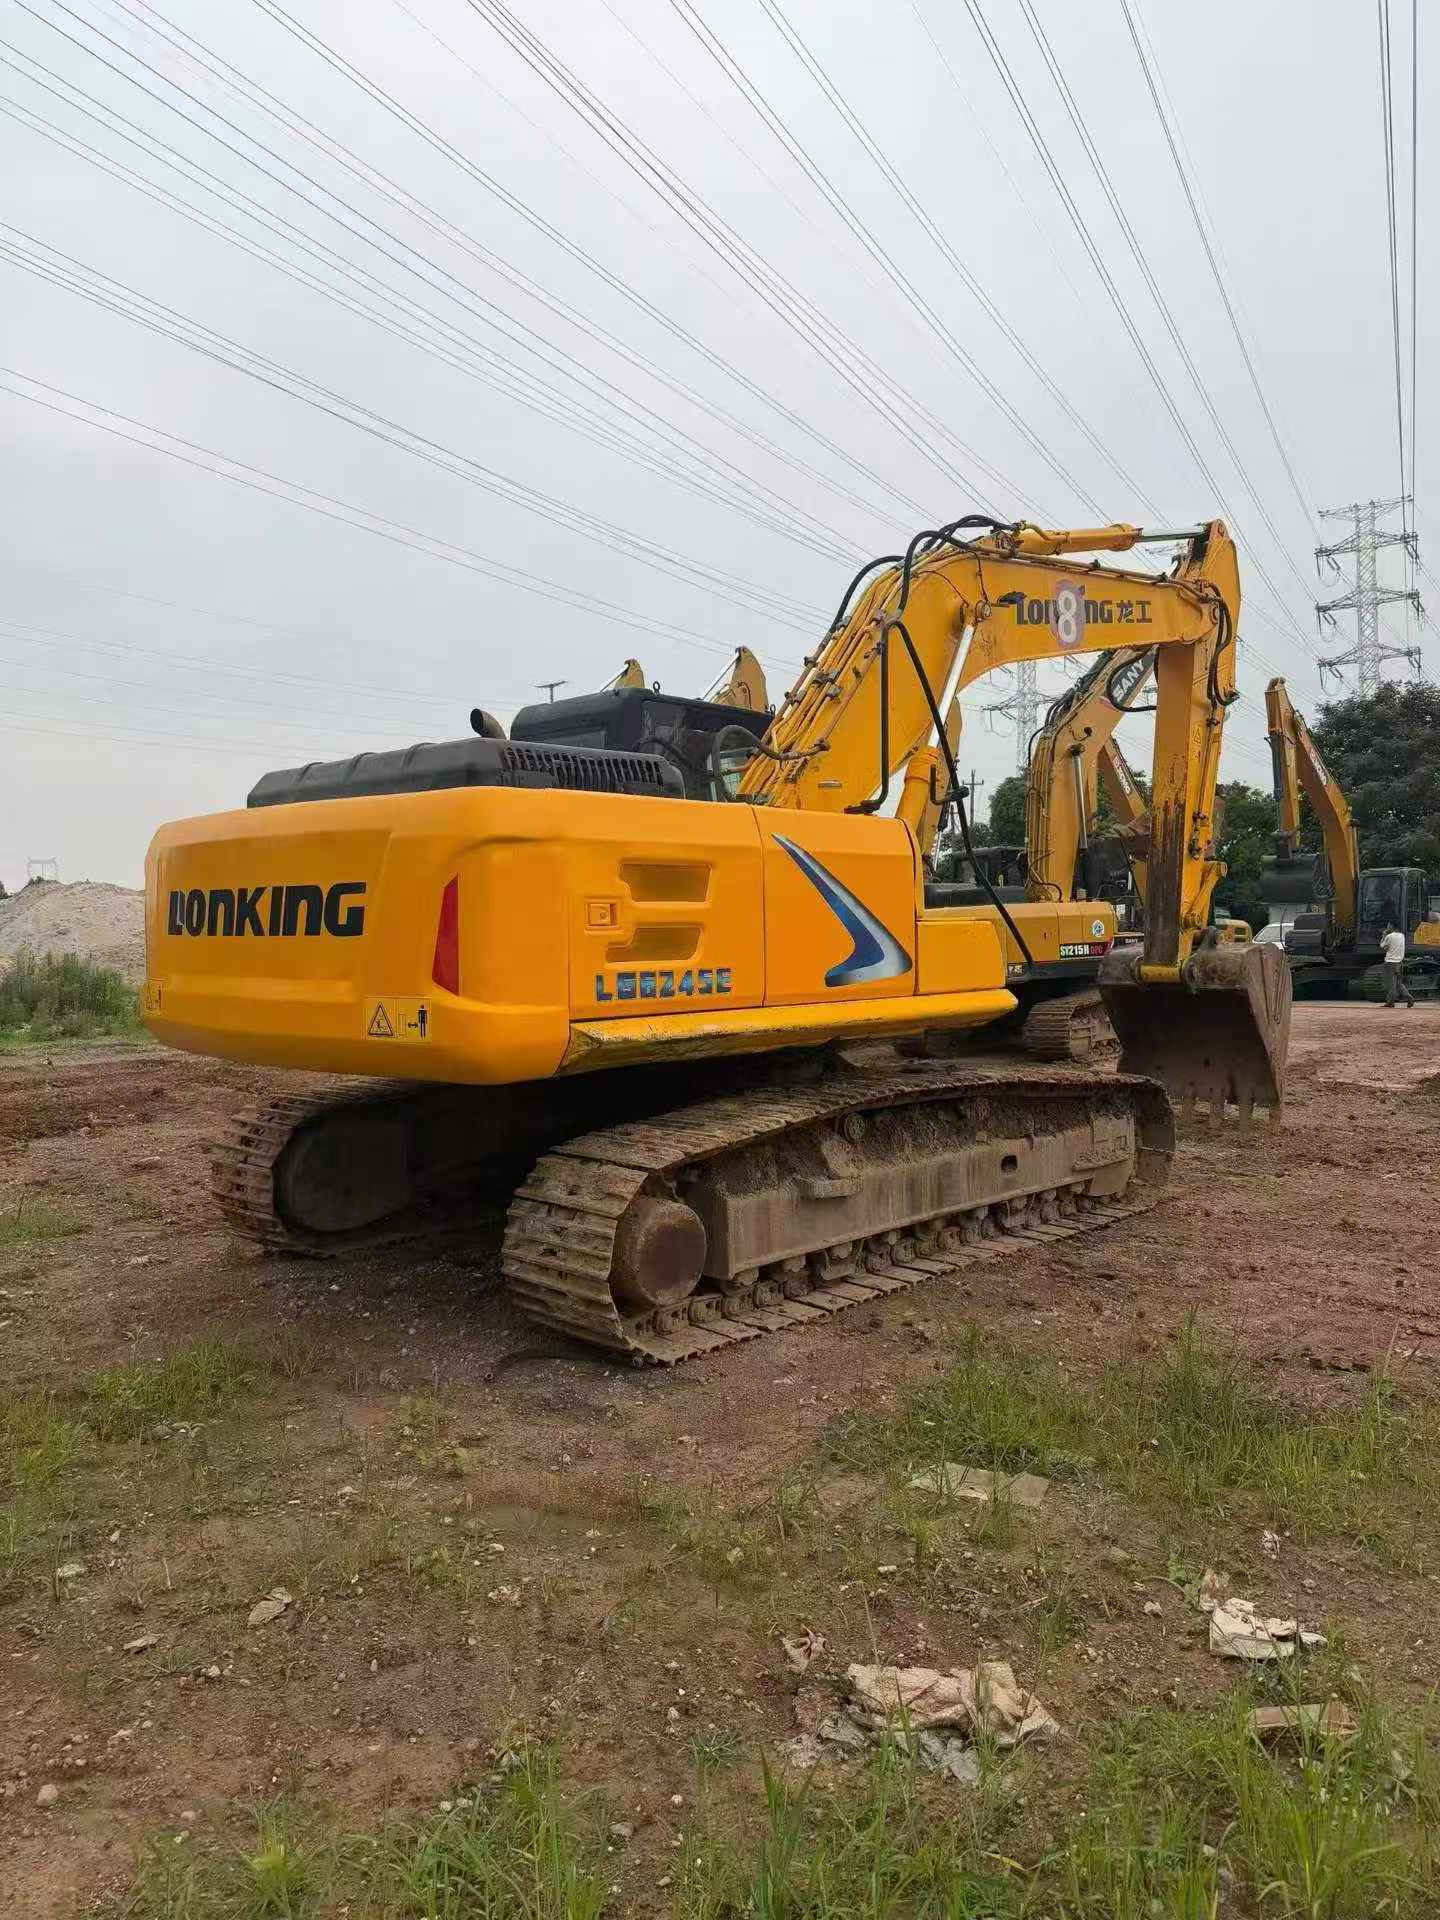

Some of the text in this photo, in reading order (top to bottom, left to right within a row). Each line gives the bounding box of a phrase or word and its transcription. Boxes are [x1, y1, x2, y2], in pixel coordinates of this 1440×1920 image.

[1057, 590, 1078, 643] 8
[1112, 659, 1144, 702] SANY
[167, 881, 368, 937] LONKING
